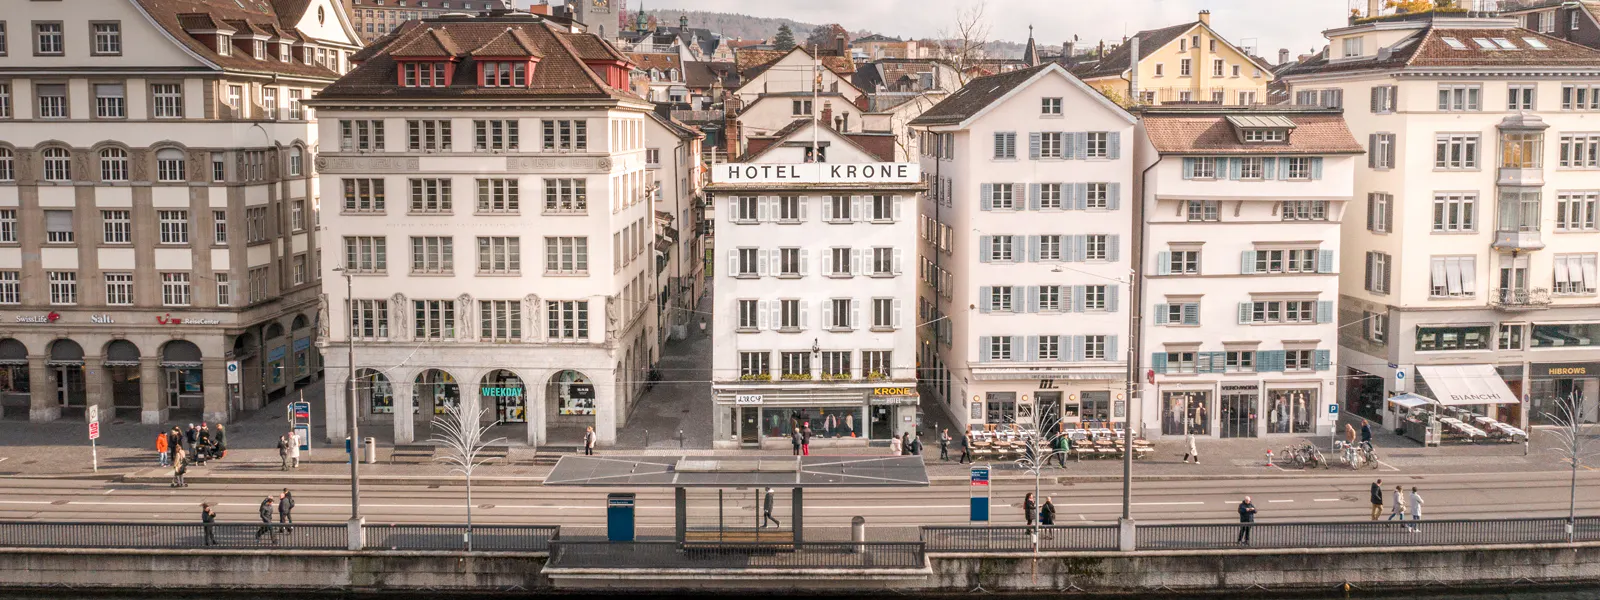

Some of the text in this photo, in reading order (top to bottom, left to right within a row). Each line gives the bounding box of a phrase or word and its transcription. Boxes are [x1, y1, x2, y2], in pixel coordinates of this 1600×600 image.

[728, 164, 908, 179] HOTEL KRONE
[1549, 367, 1586, 375] HIBROWS
[482, 387, 522, 397] WEEKDAY
[874, 387, 911, 395] KRONE
[1450, 393, 1501, 401] BIANCHI
